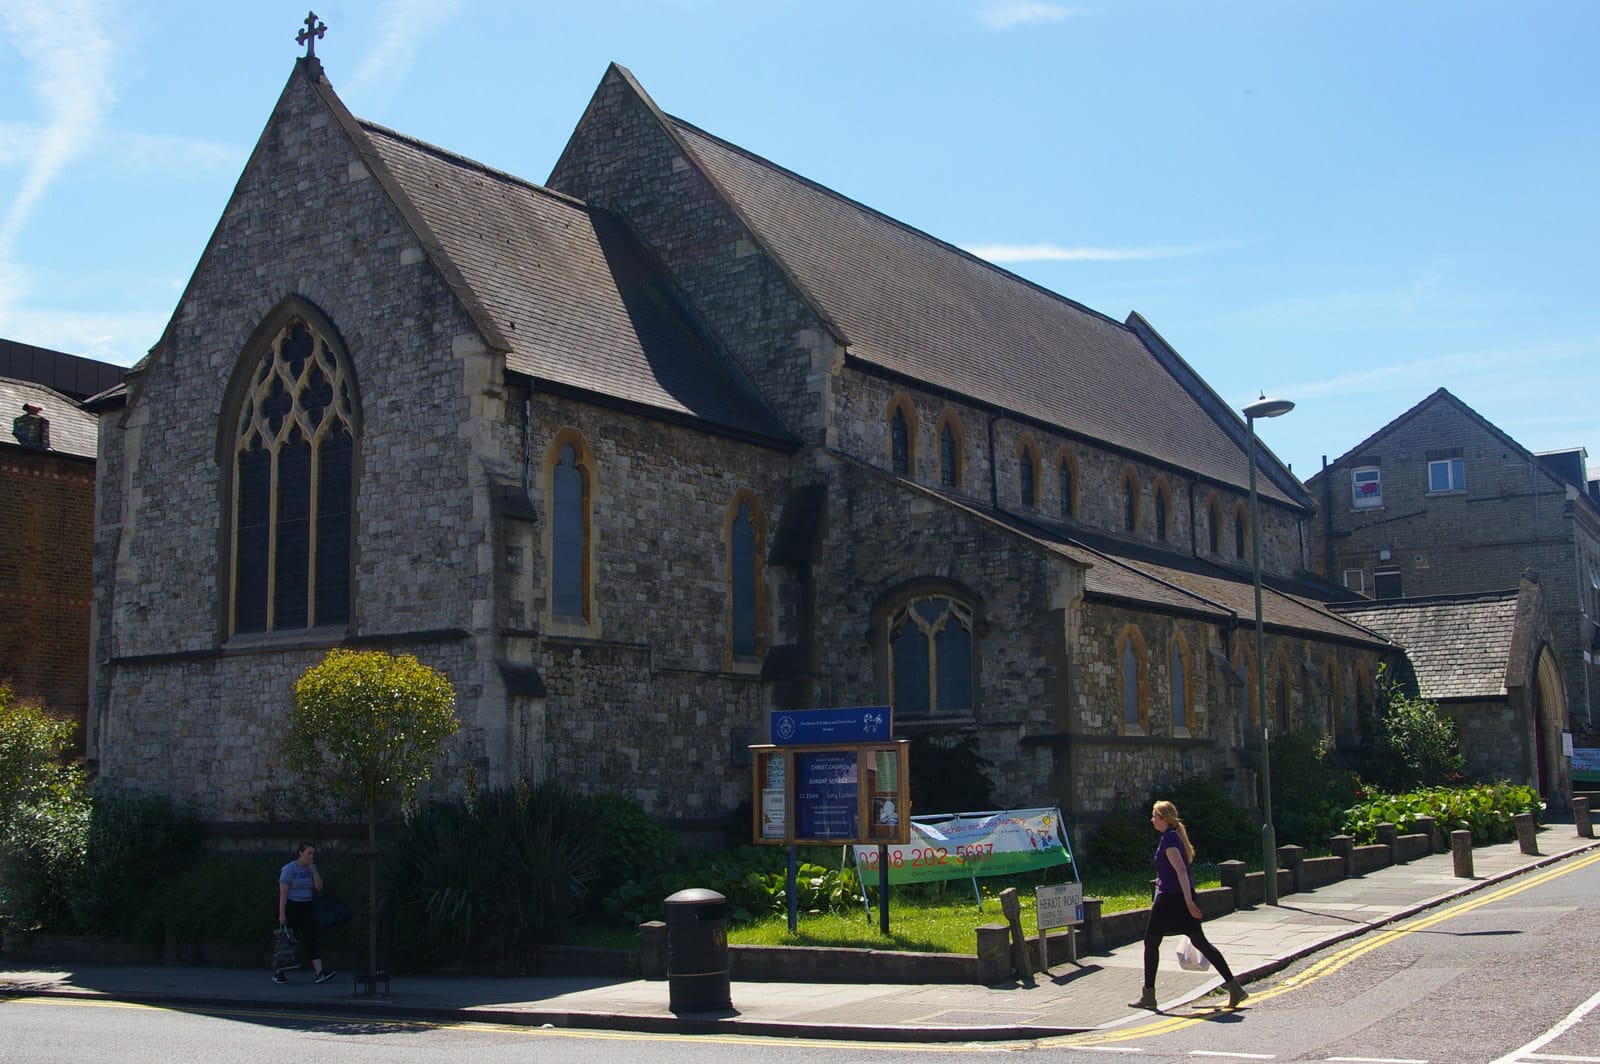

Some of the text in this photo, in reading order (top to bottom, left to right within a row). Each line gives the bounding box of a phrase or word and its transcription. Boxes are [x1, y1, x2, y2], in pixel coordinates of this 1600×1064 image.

[940, 824, 967, 835] School
[998, 817, 1027, 827] Nursery
[911, 847, 949, 867] 202
[956, 843, 994, 865] 5687
[1063, 894, 1080, 907] ROAD
